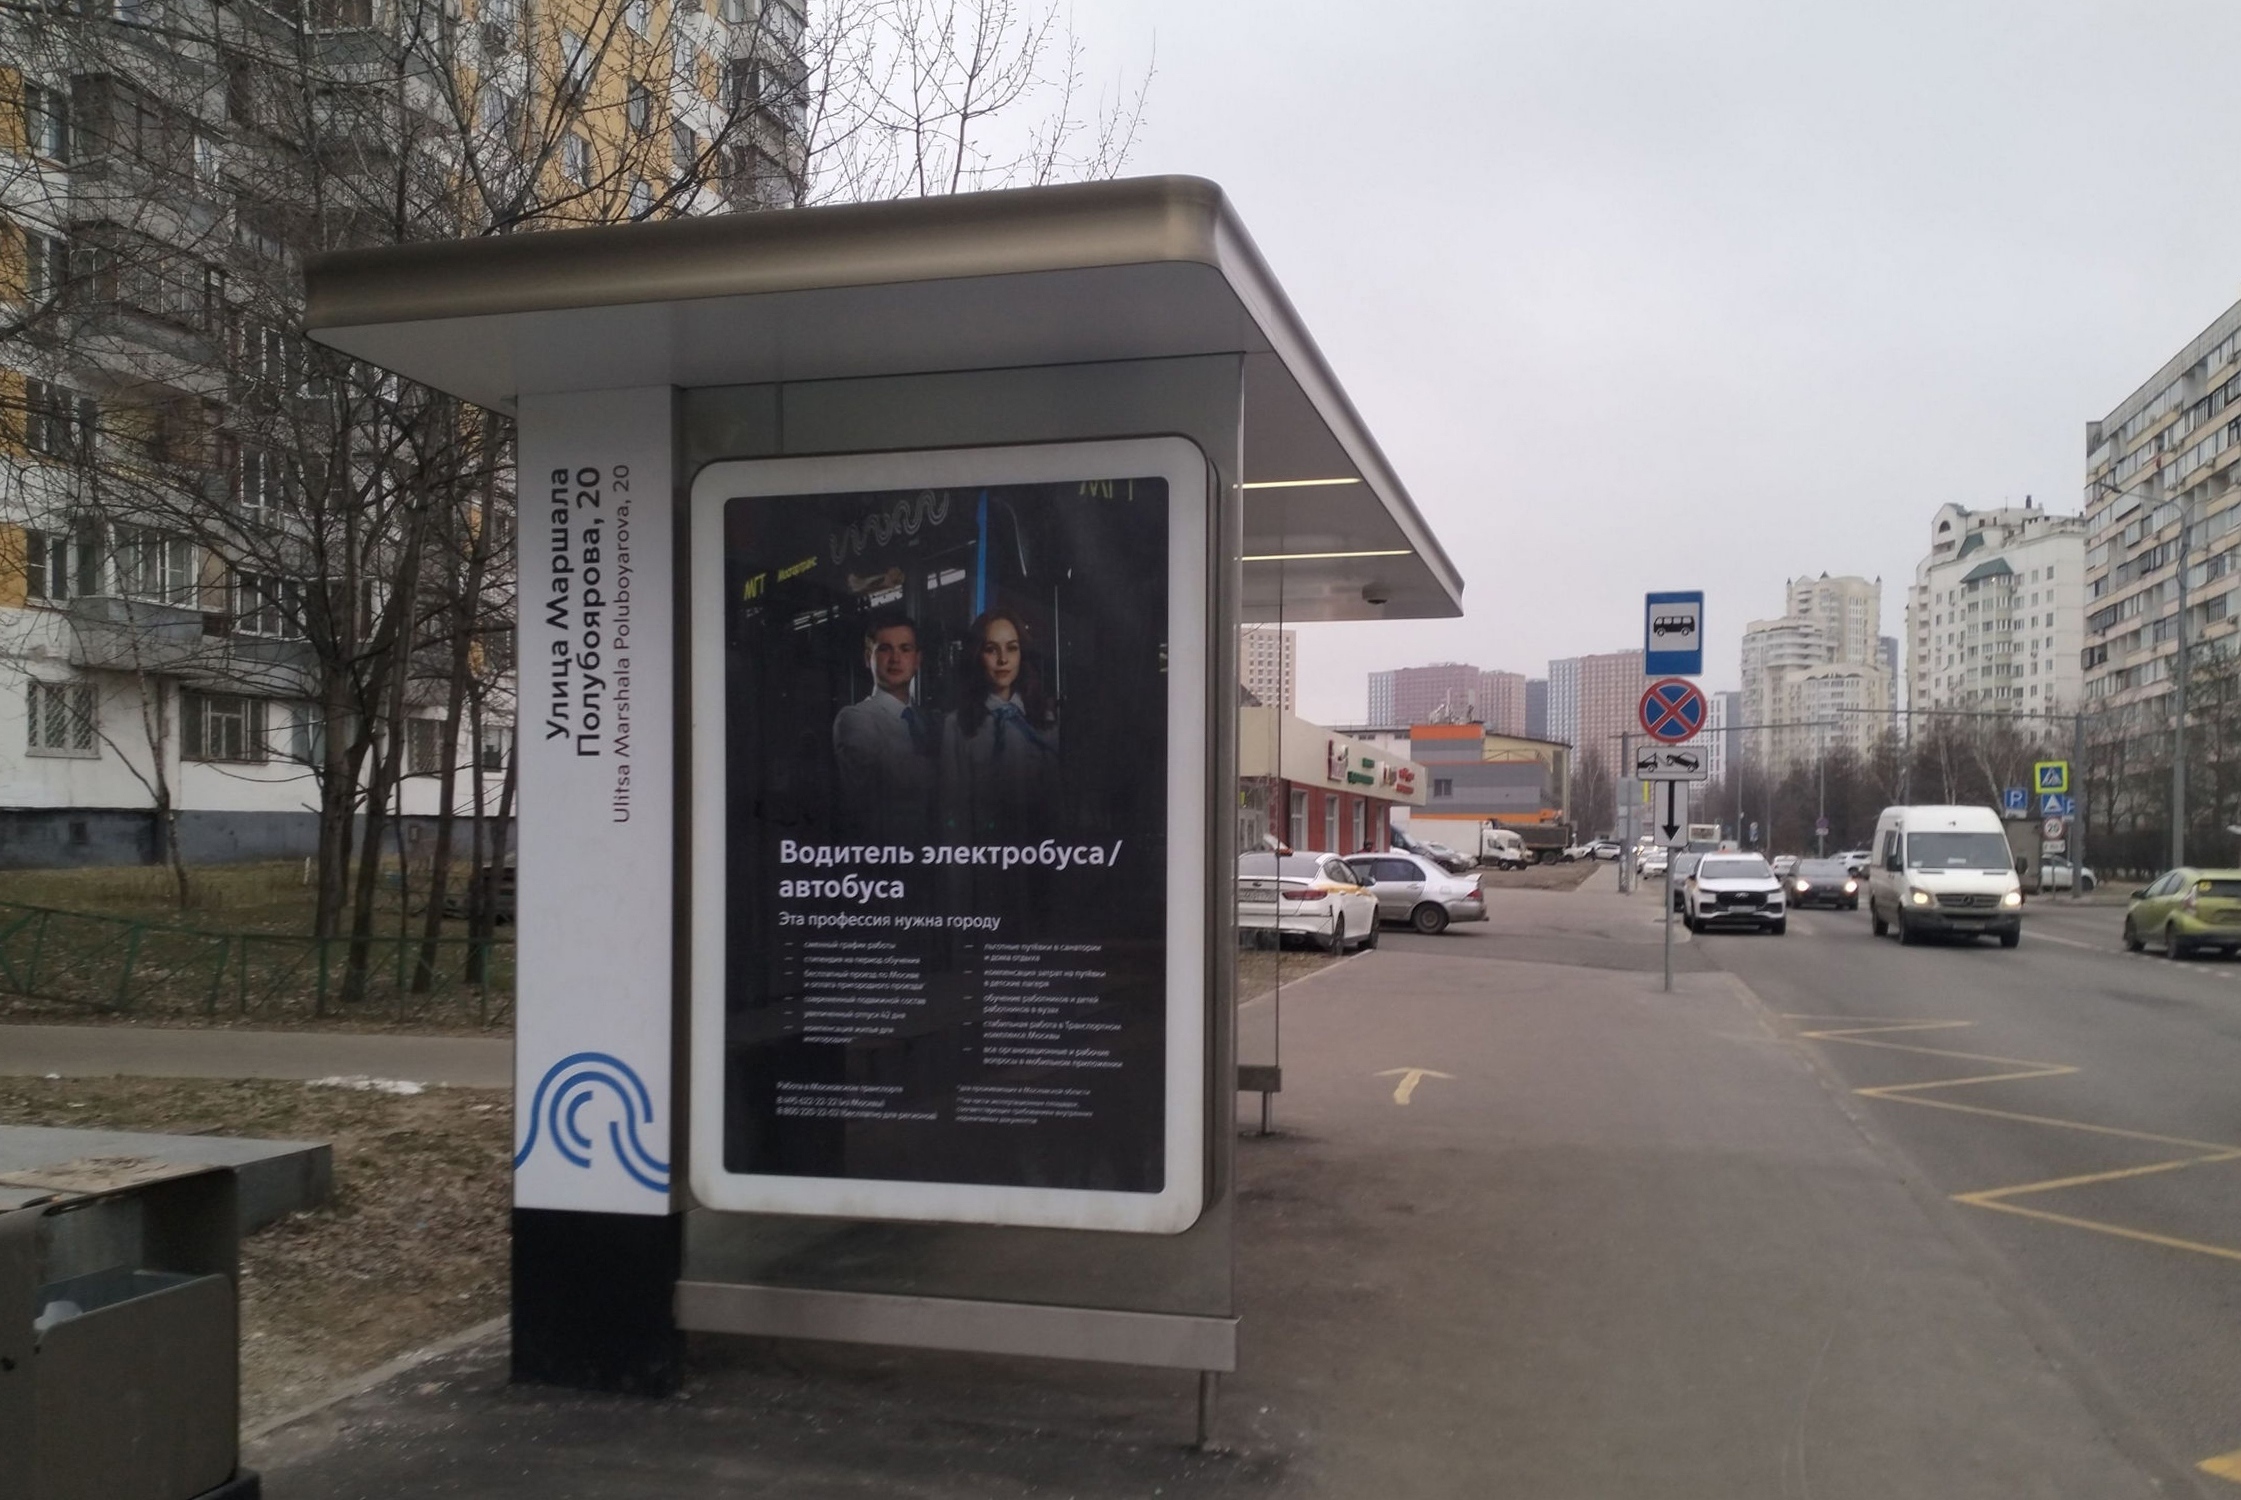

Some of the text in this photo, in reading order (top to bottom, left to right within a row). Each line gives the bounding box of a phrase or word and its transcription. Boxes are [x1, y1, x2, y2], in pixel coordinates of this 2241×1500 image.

[546, 467, 574, 741] Улица Маршала
[576, 466, 606, 757] Полубоярова, 20
[613, 464, 634, 823] Ulitsa Marshala Poluboyarova, 20
[2010, 790, 2023, 808] P
[779, 839, 1123, 870] Водитель электробуса/
[779, 874, 905, 903] автобуса
[779, 911, 1001, 931] Эта профессия нужна городу
